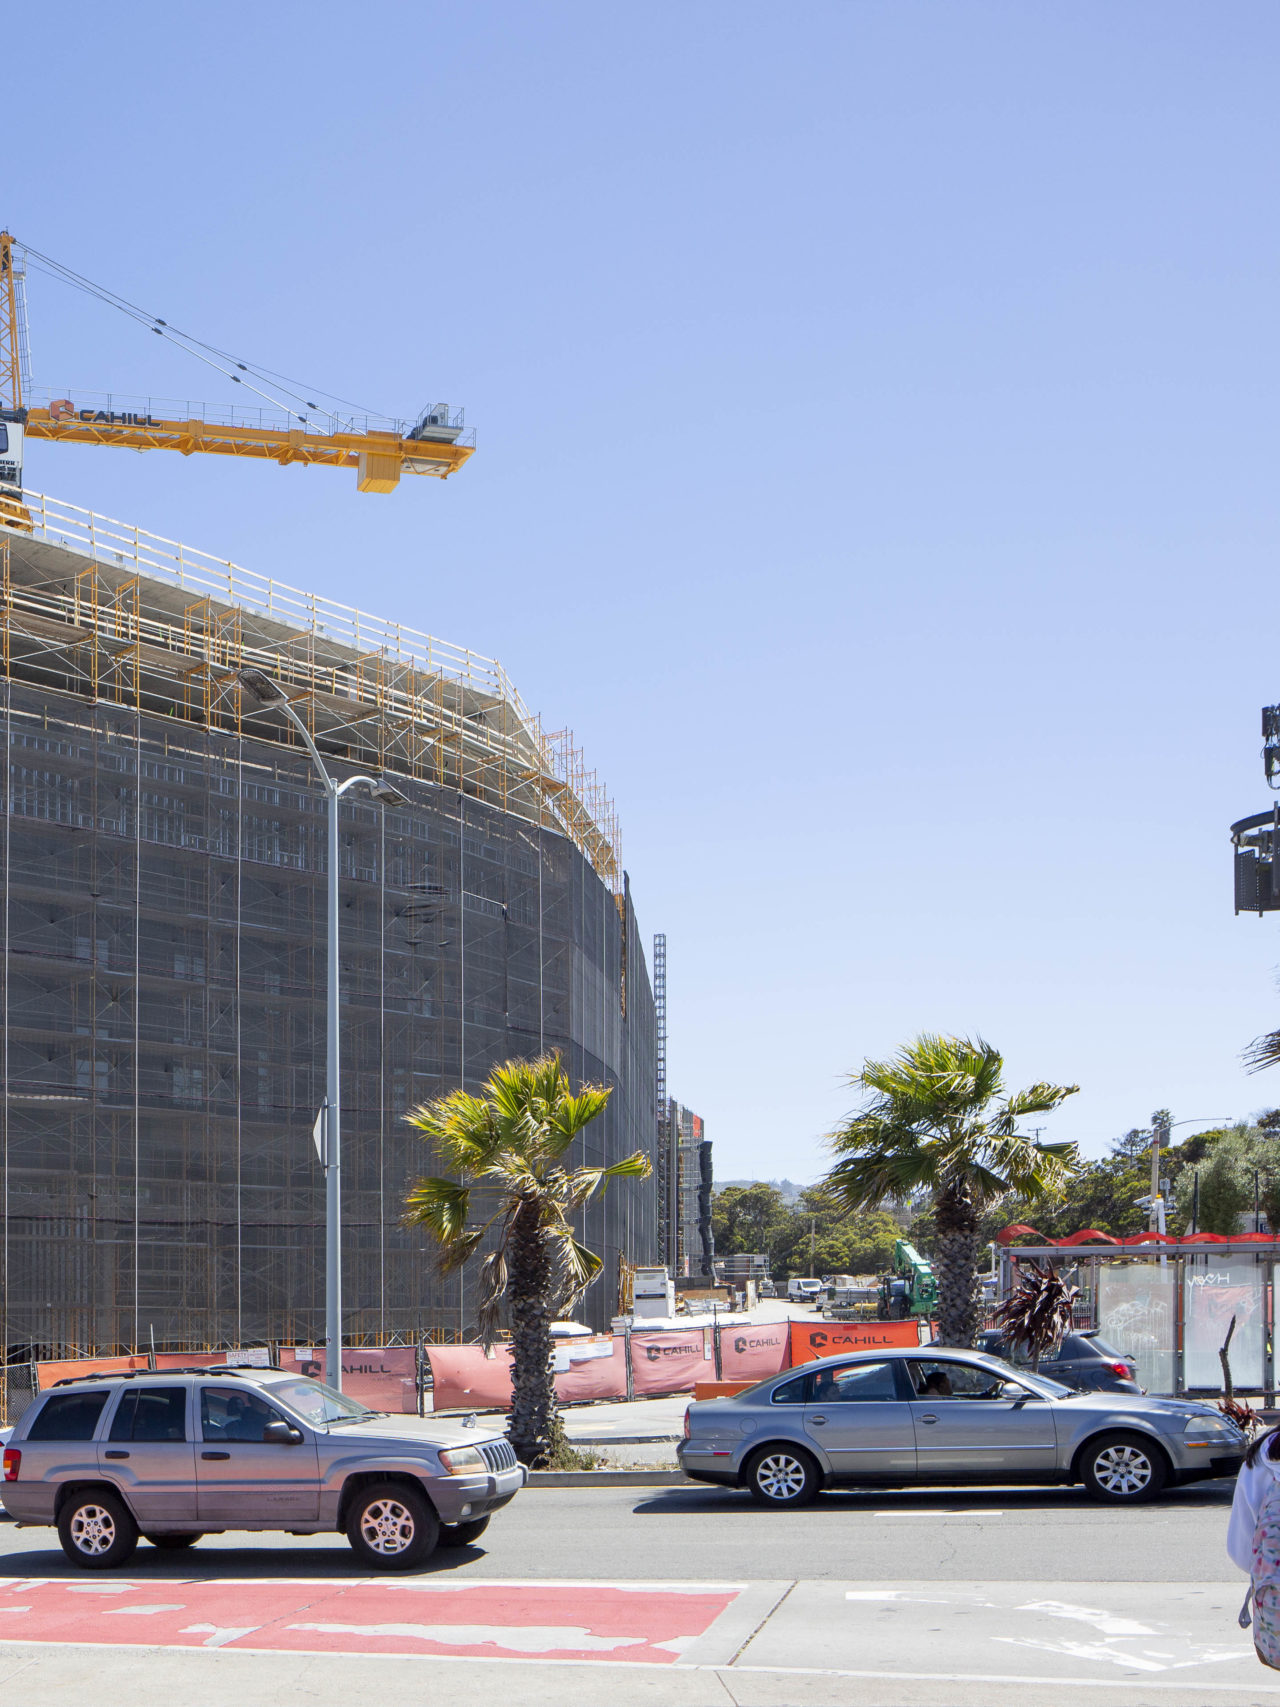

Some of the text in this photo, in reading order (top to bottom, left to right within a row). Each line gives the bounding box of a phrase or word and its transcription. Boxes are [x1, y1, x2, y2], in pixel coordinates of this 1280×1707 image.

[79, 409, 161, 427] CAHILL
[748, 1337, 781, 1348] CAHILL
[831, 1335, 894, 1344] CAHILL
[663, 1344, 702, 1356] CAHILL
[341, 1364, 392, 1374] AHILL
